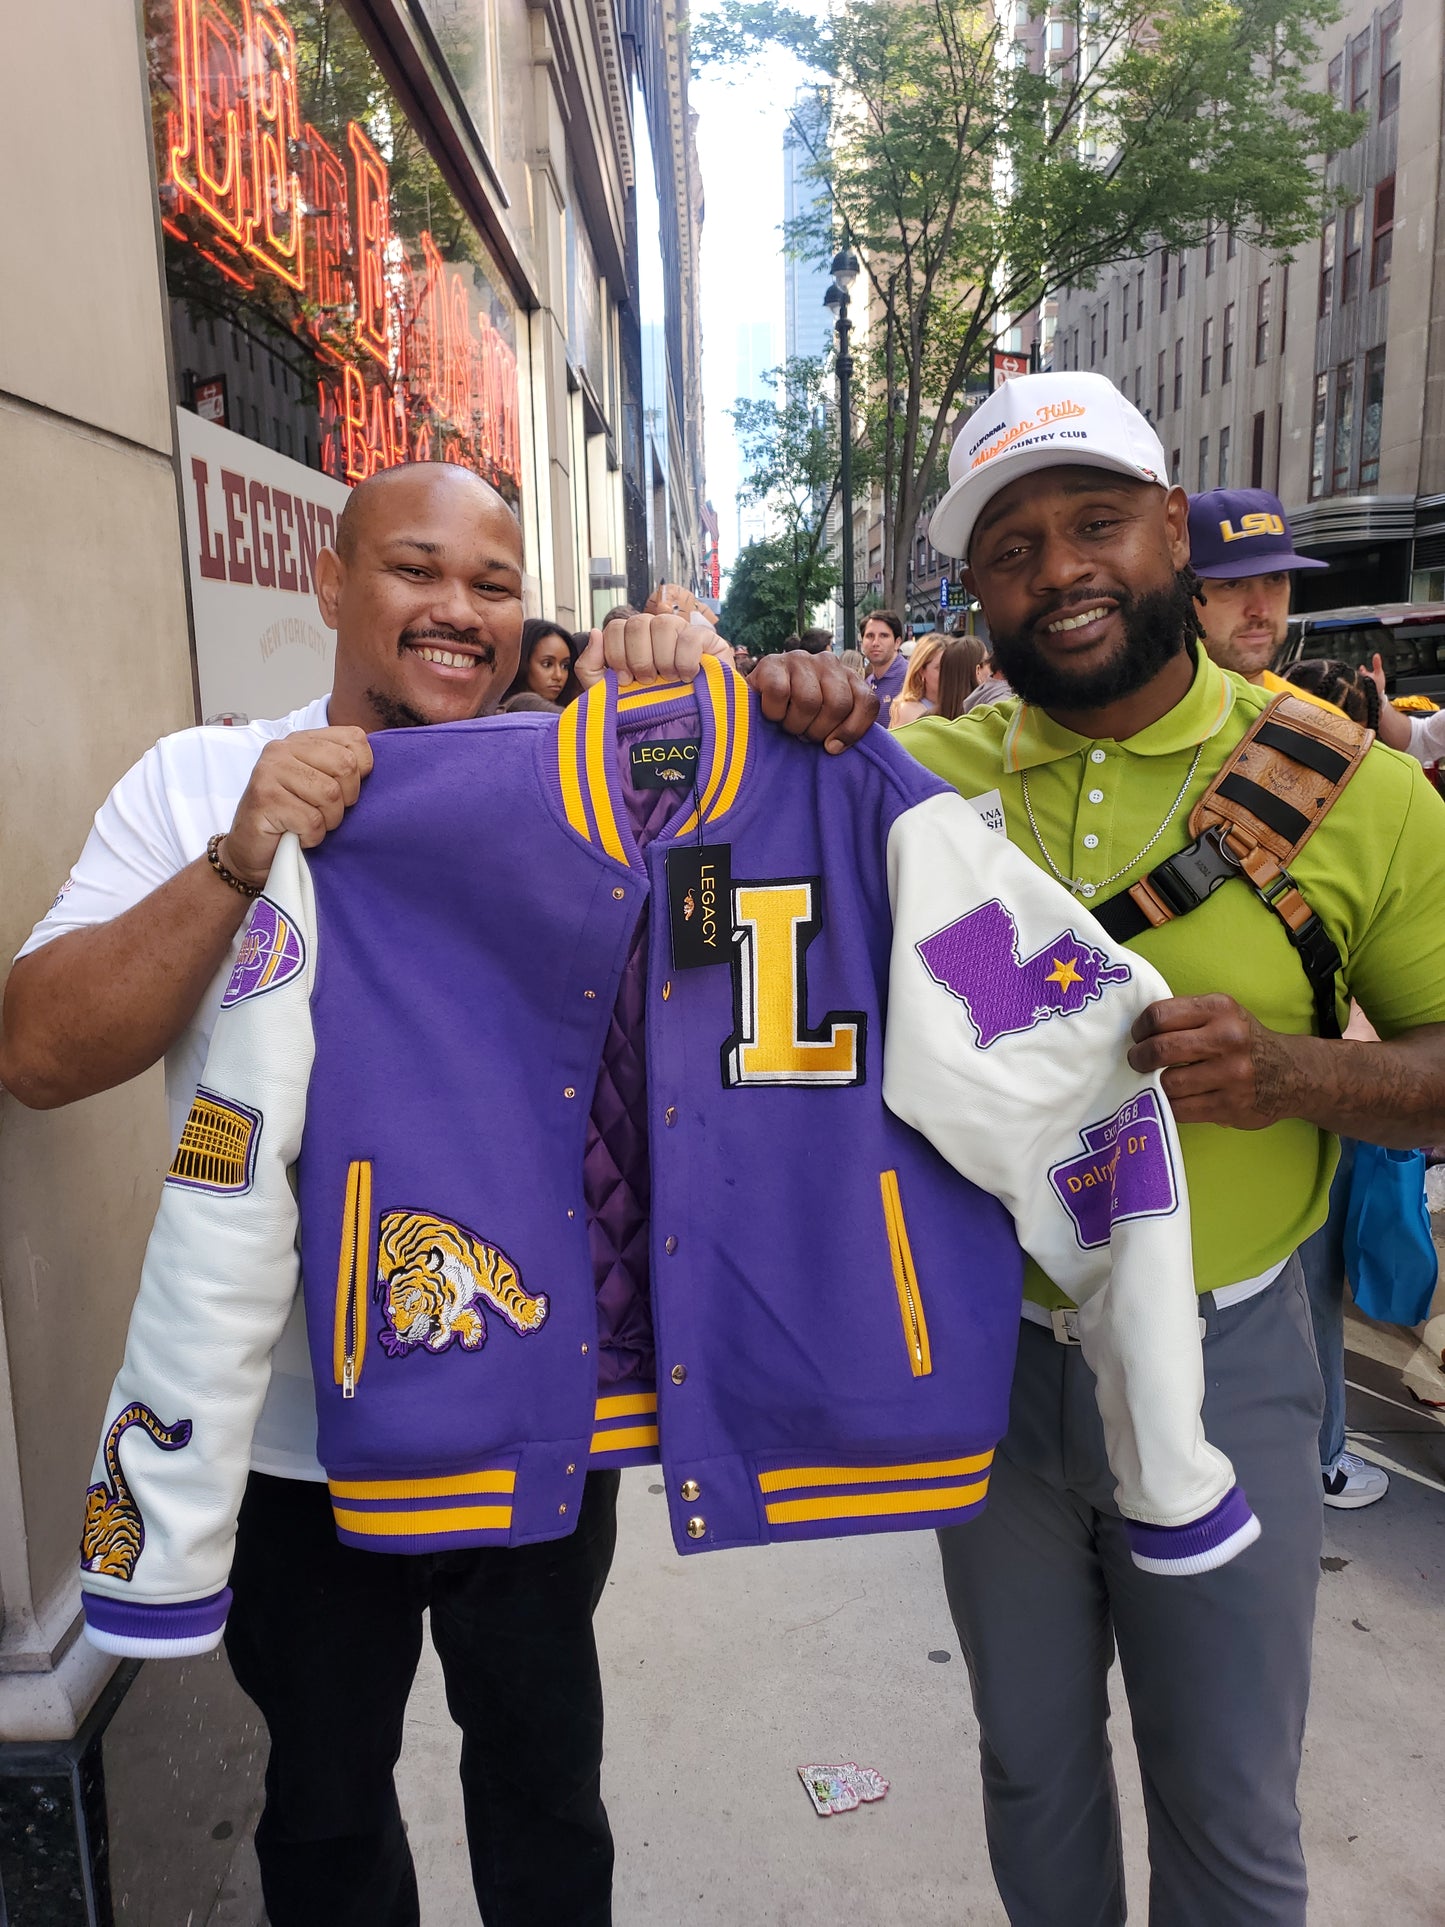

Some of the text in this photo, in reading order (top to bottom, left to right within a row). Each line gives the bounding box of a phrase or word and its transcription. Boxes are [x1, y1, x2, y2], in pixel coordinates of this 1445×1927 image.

[969, 422, 1006, 456] CALIFORNIA
[971, 400, 1086, 469] Mission Hills
[1003, 431, 1088, 453] OUNTRY CLUB
[1219, 513, 1285, 543] LSU
[259, 617, 328, 664] NEW YORK CITY
[701, 864, 717, 948] LEGACY
[730, 882, 859, 1087] L
[1103, 1124, 1118, 1142] EXIT
[1128, 1135, 1148, 1155] Dr
